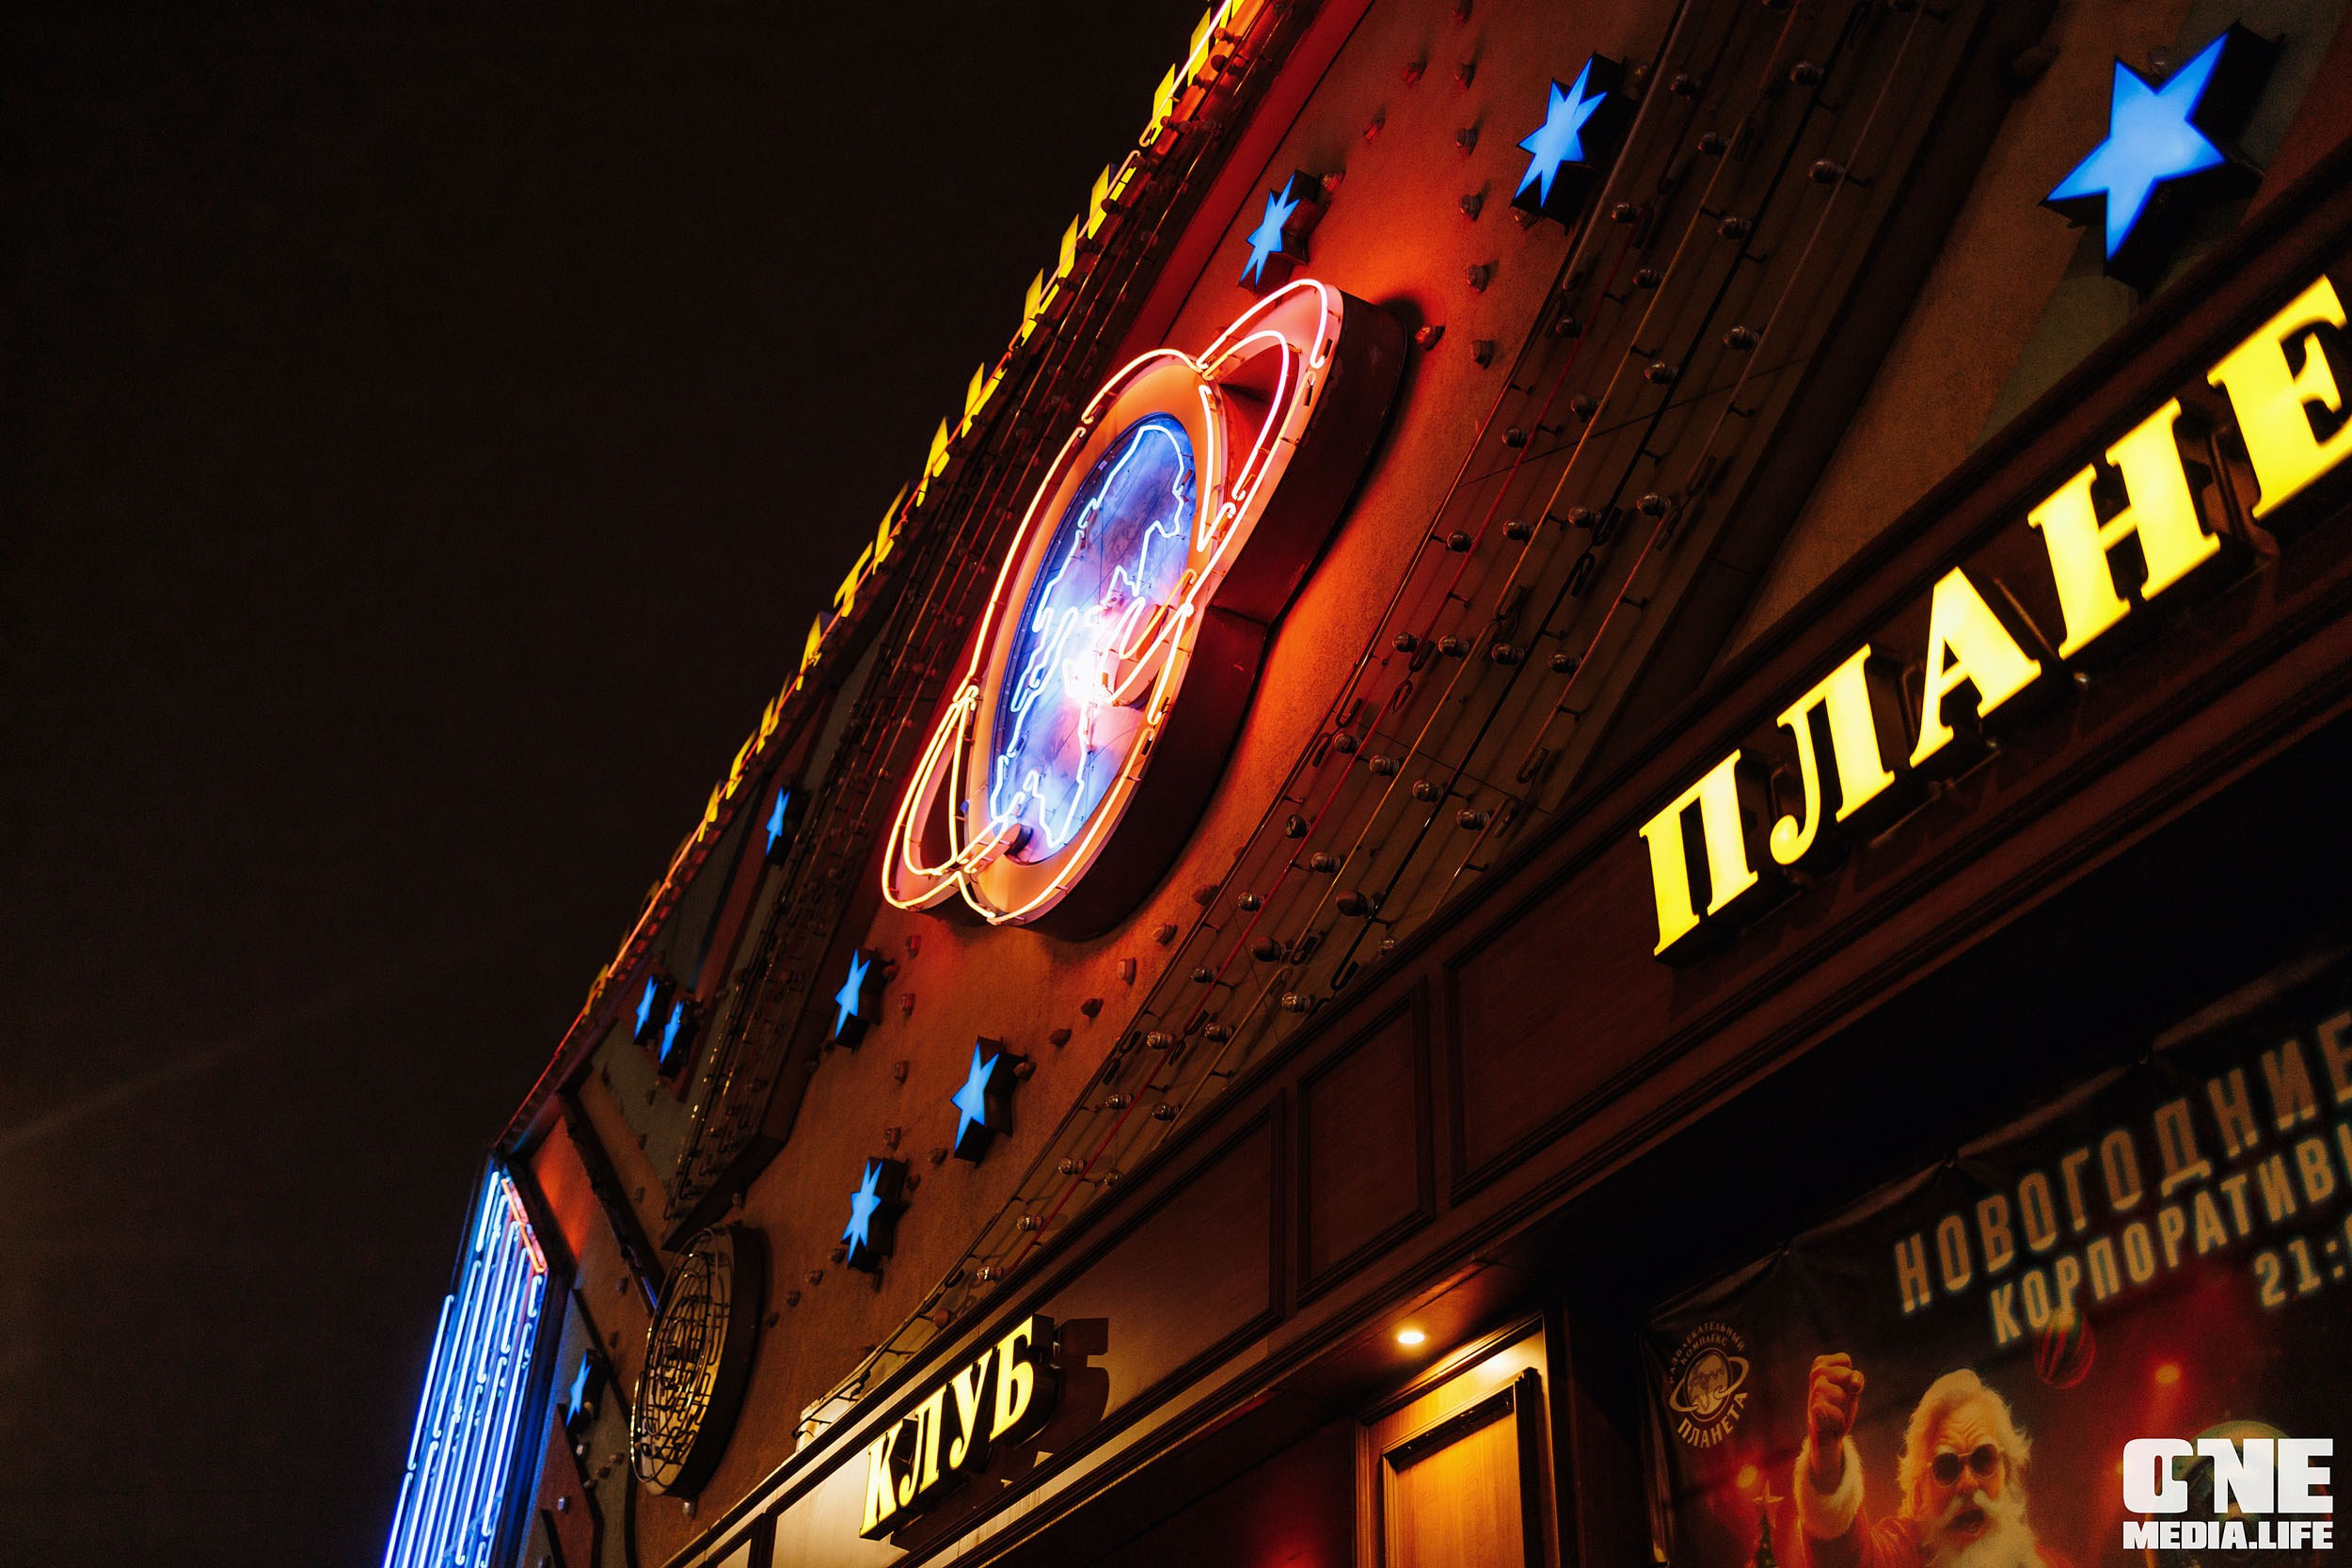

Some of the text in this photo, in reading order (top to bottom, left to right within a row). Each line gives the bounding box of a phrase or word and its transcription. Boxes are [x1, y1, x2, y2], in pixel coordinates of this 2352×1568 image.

[1638, 274, 2352, 957] ПЛАНЕ
[2254, 1212, 2352, 1309] 21:
[859, 1316, 1035, 1539] КЛУБ
[1677, 1392, 1748, 1449] ПЛАНЕТА
